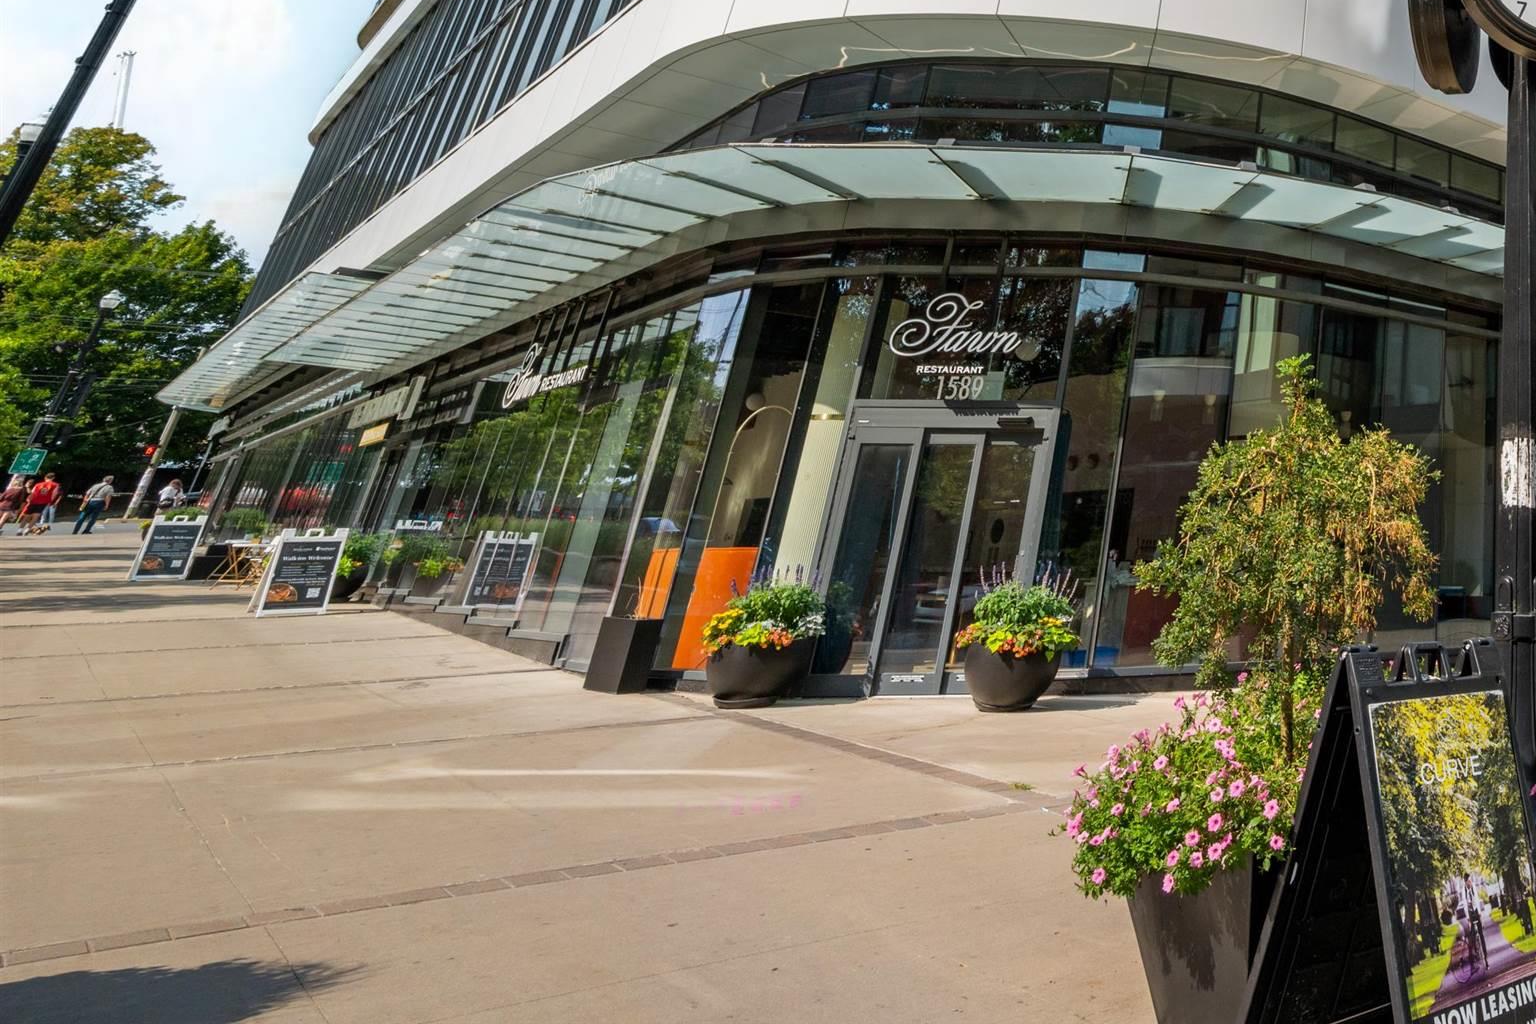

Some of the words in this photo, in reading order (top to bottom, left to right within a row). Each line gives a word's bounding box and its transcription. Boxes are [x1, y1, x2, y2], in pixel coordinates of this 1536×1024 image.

[1516, 1, 1528, 18] 7
[889, 292, 1022, 357] Fawn
[539, 365, 589, 393] RESTAURANT
[915, 365, 984, 374] RESTAURANT
[1420, 755, 1482, 785] CURVE
